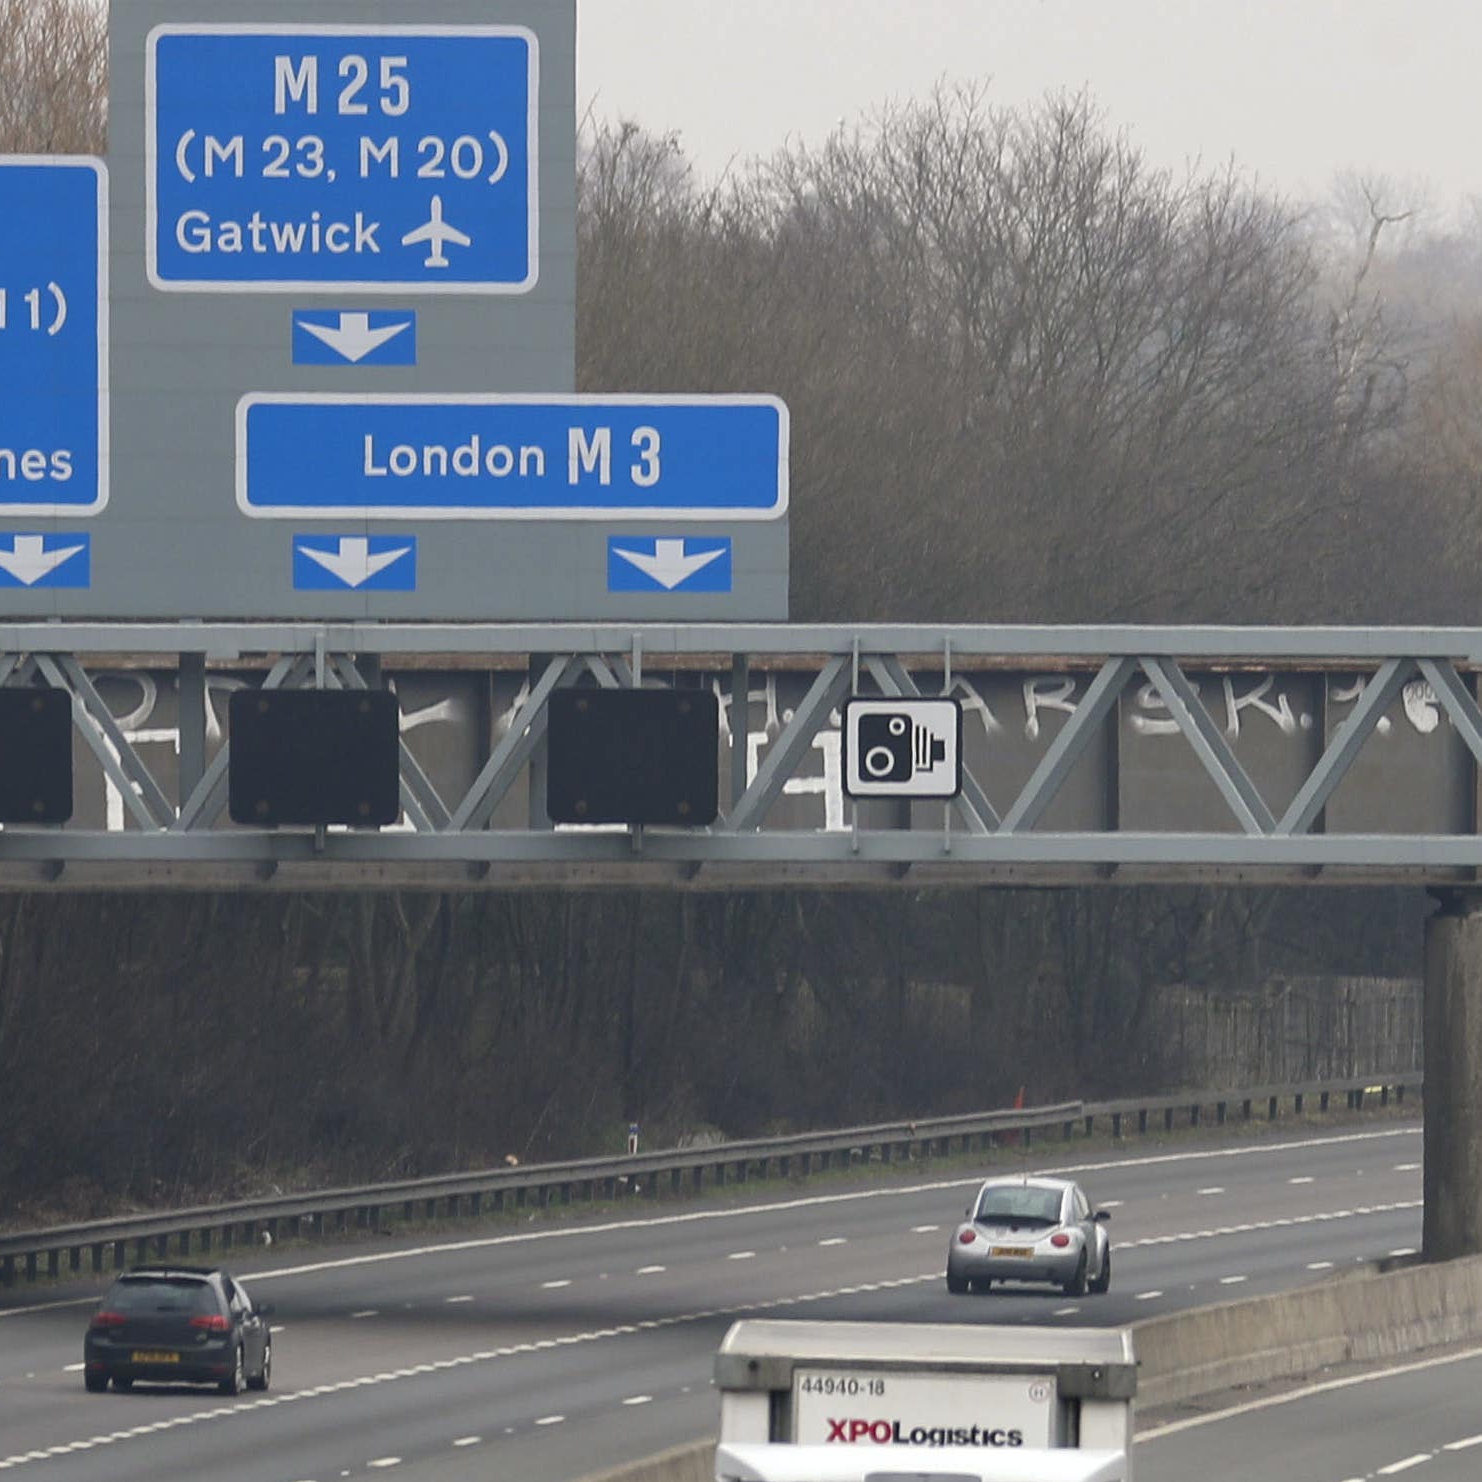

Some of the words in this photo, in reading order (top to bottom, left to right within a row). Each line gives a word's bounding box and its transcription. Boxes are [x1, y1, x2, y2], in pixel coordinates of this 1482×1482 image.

[176, 211, 381, 253] Gatwick
[364, 435, 545, 477] London
[800, 1377, 886, 1397] 44940-18
